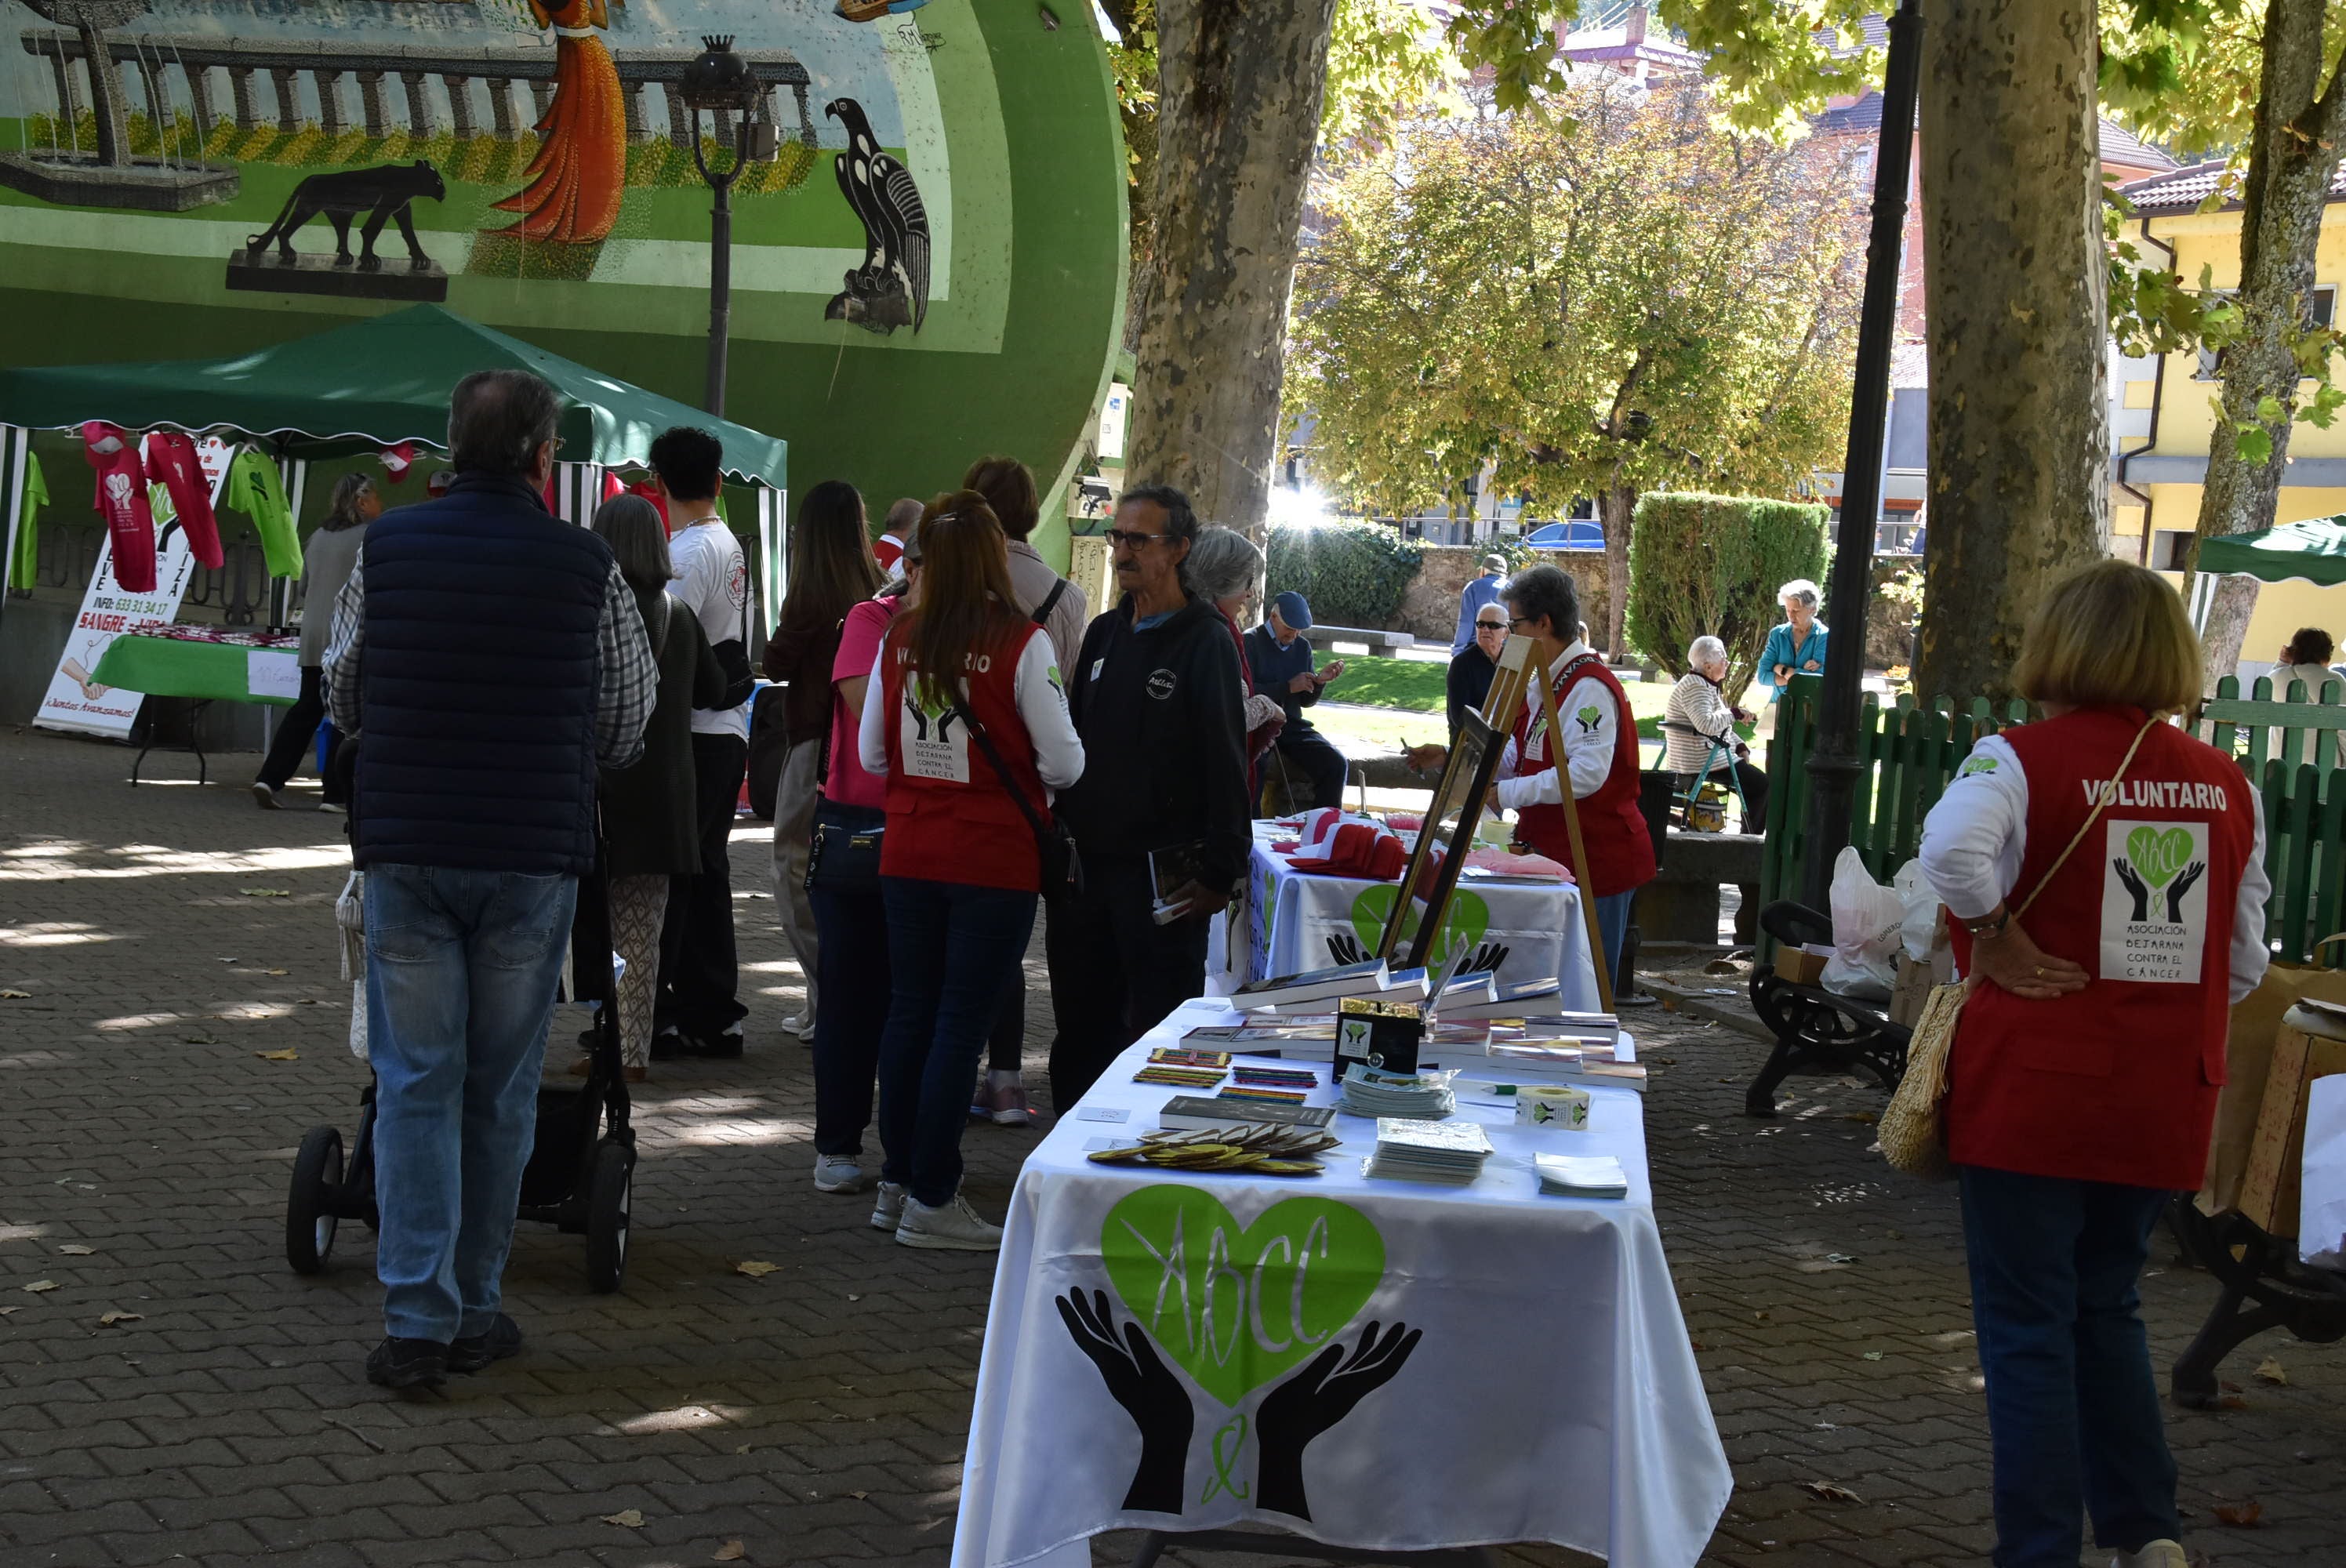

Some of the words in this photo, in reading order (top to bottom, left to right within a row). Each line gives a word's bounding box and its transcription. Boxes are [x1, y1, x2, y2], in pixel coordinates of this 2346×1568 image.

[93, 597, 114, 609] INFO:
[115, 598, 130, 612] 633
[131, 600, 143, 612] 31
[143, 601, 154, 614] 34
[156, 603, 168, 615] 17
[79, 612, 127, 632] SANGRE
[79, 702, 135, 718] Avanzamos!
[2082, 779, 2227, 811] VOLUNTARIO
[2127, 924, 2187, 935] ASOCIACIÓN
[2126, 939, 2184, 950] BEJARANA
[2127, 953, 2167, 964] CONTRA
[2172, 955, 2182, 964] EL
[1119, 1203, 1328, 1367] ABCC
